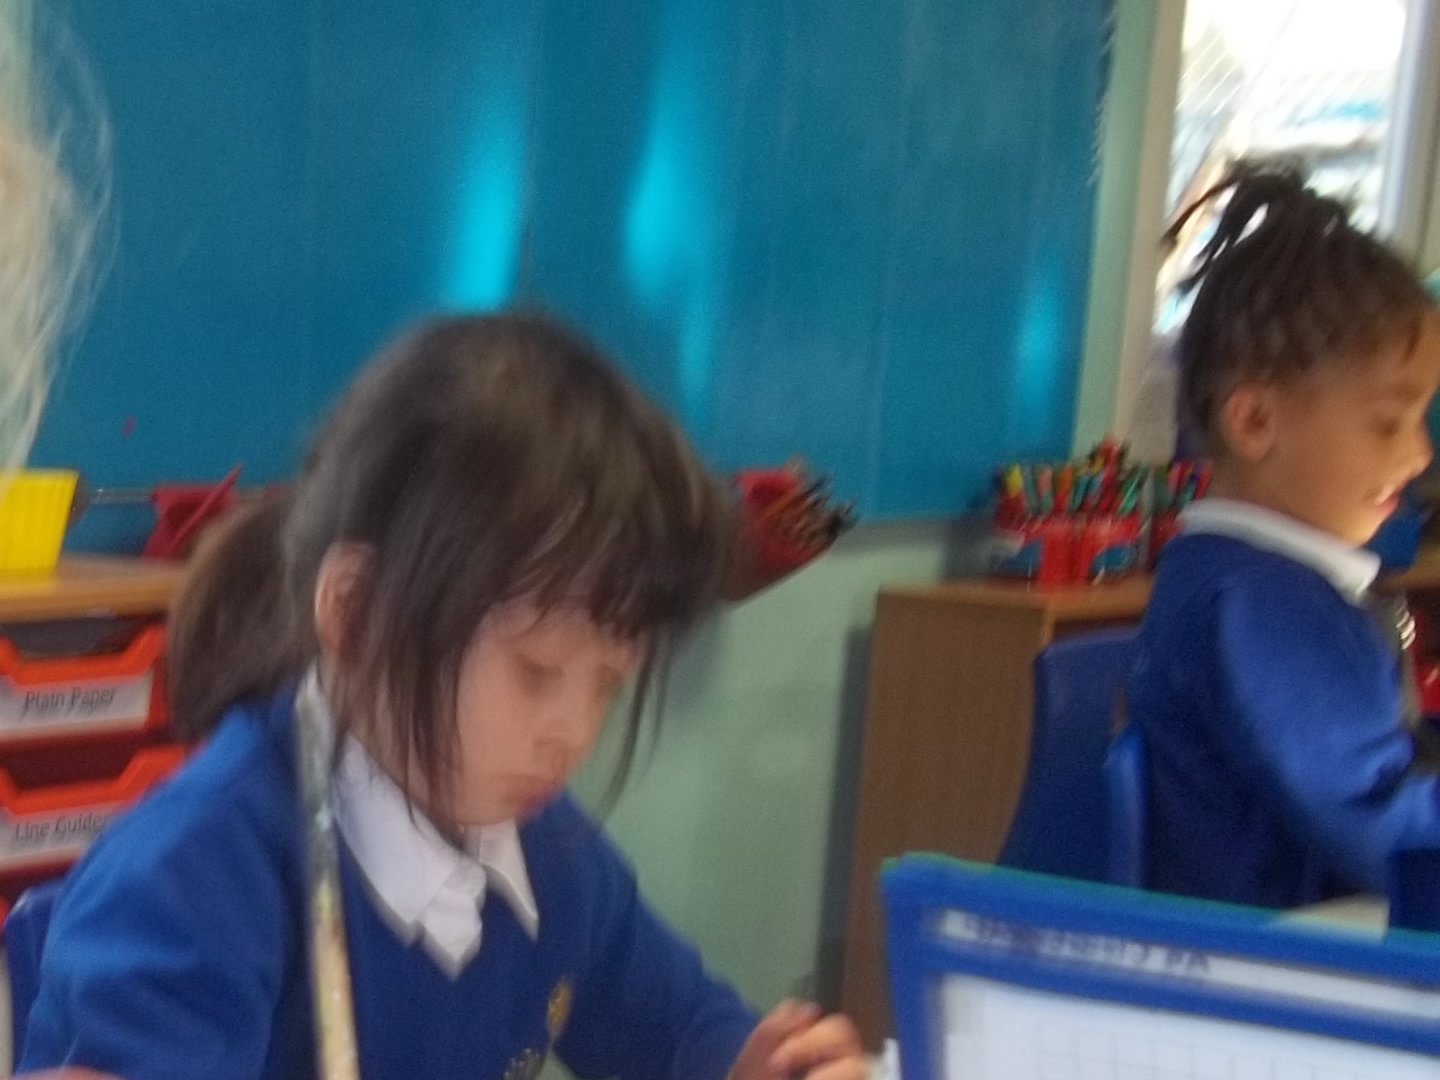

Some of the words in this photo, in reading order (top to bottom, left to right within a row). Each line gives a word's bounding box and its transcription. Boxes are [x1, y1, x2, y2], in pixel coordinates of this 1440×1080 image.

[23, 687, 65, 713] Plain
[69, 684, 118, 711] Paper
[14, 819, 50, 842] Line
